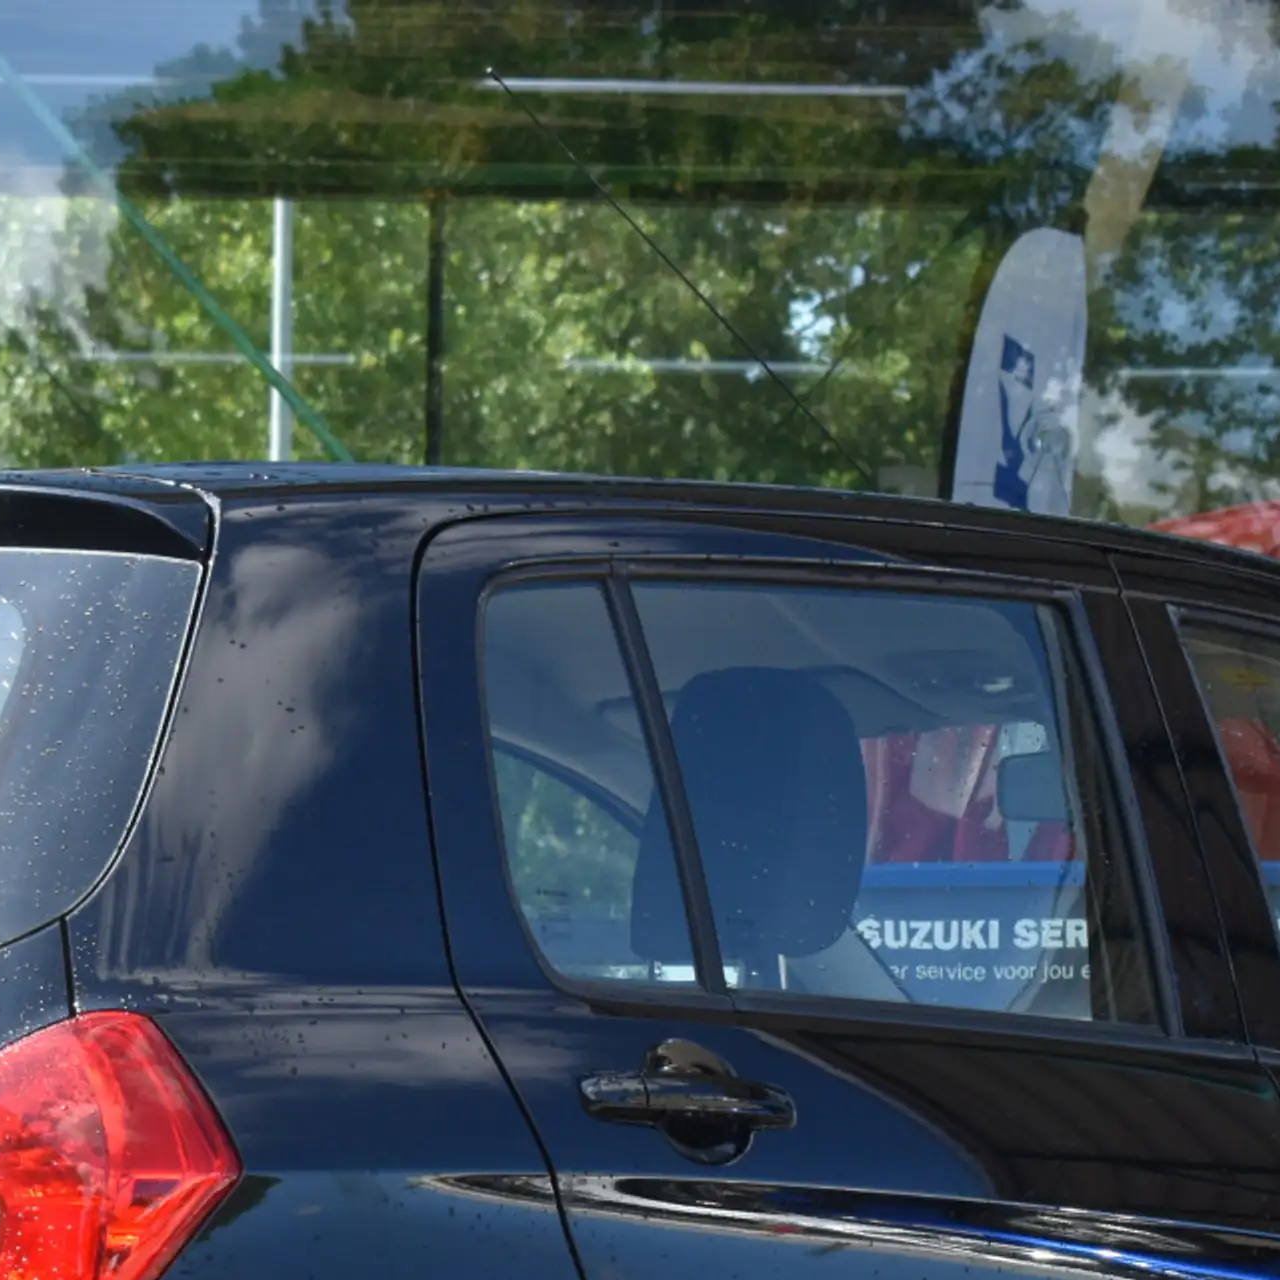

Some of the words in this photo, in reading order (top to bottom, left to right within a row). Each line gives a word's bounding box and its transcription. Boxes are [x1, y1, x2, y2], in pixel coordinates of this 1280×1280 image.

[857, 919, 1000, 950] SUZUKI
[1013, 918, 1089, 948] SER
[916, 962, 987, 982] service
[993, 965, 1036, 980] voor
[1041, 960, 1074, 984] jou
